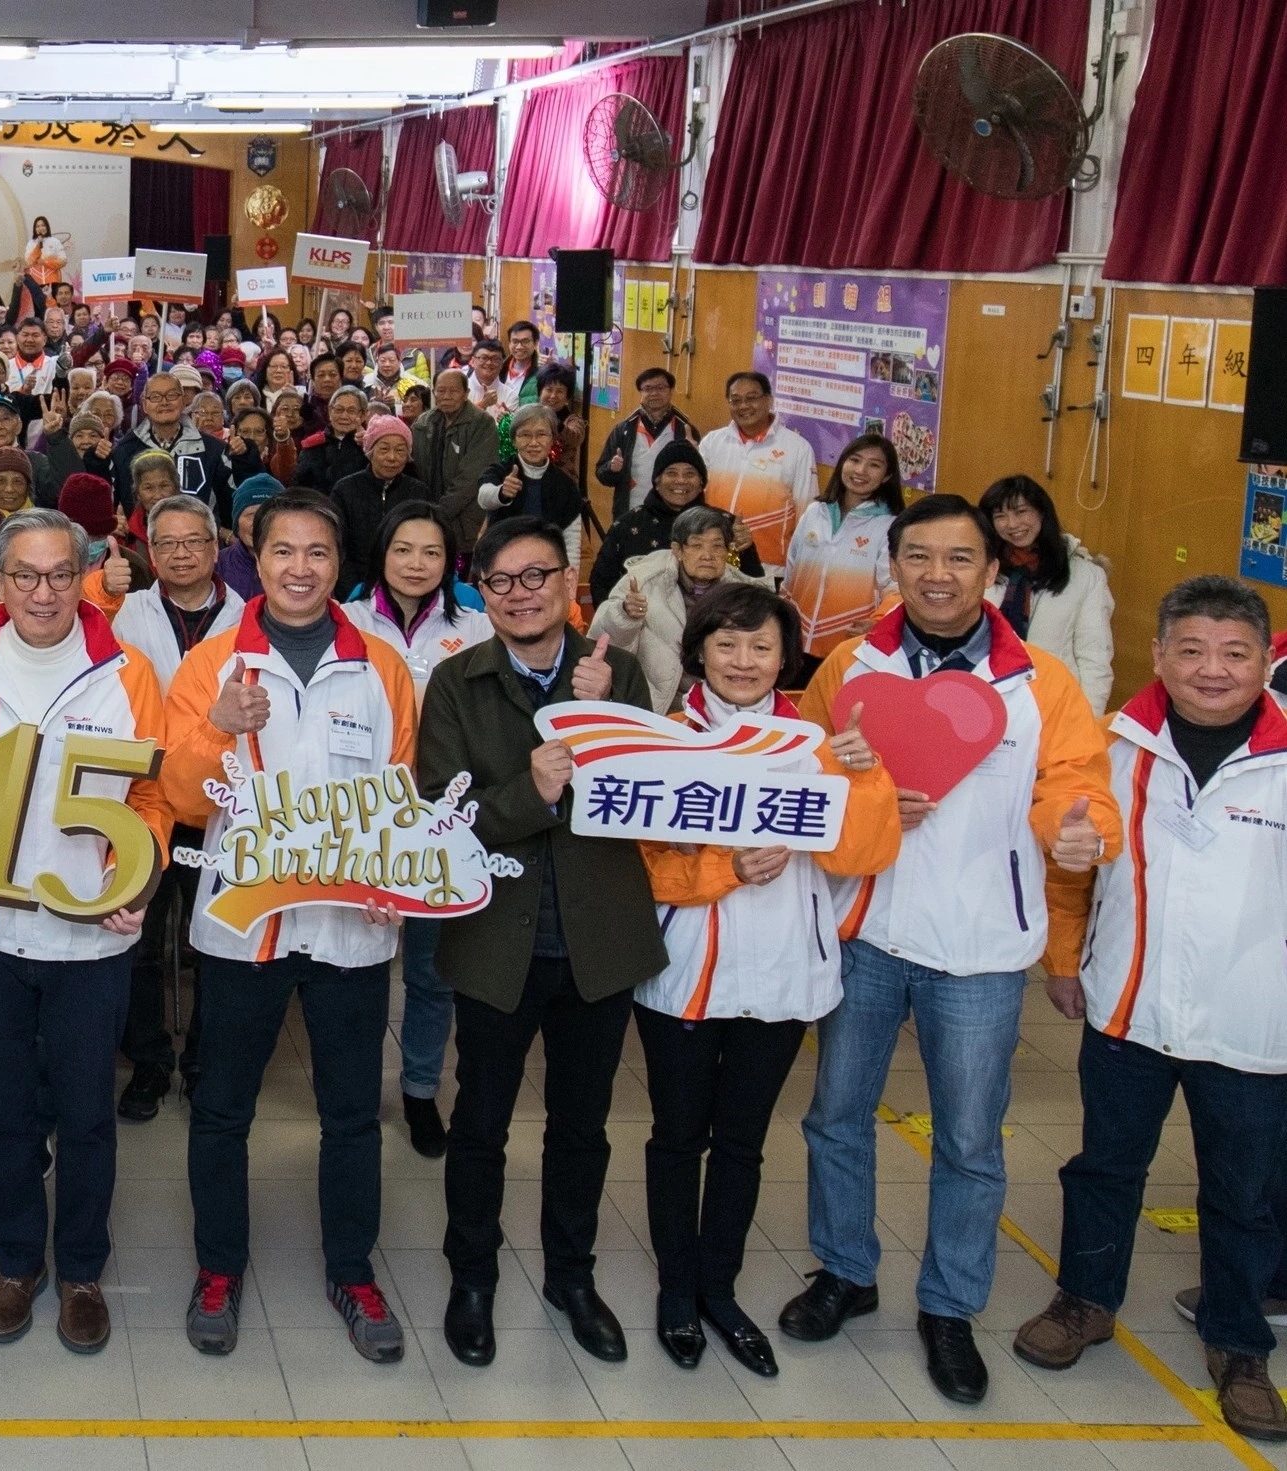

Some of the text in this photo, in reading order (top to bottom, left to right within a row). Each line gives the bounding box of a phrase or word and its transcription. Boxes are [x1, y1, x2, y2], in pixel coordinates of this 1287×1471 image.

[309, 247, 352, 265] KLPS
[401, 310, 464, 320] FREE DUTY
[1135, 343, 1248, 378] 四年級
[67, 722, 113, 735] 新創建 NWS
[252, 766, 434, 838] Happy
[587, 774, 831, 838] 新創建
[1230, 813, 1287, 831] 新創建 NWS
[220, 827, 465, 909] Birthday
